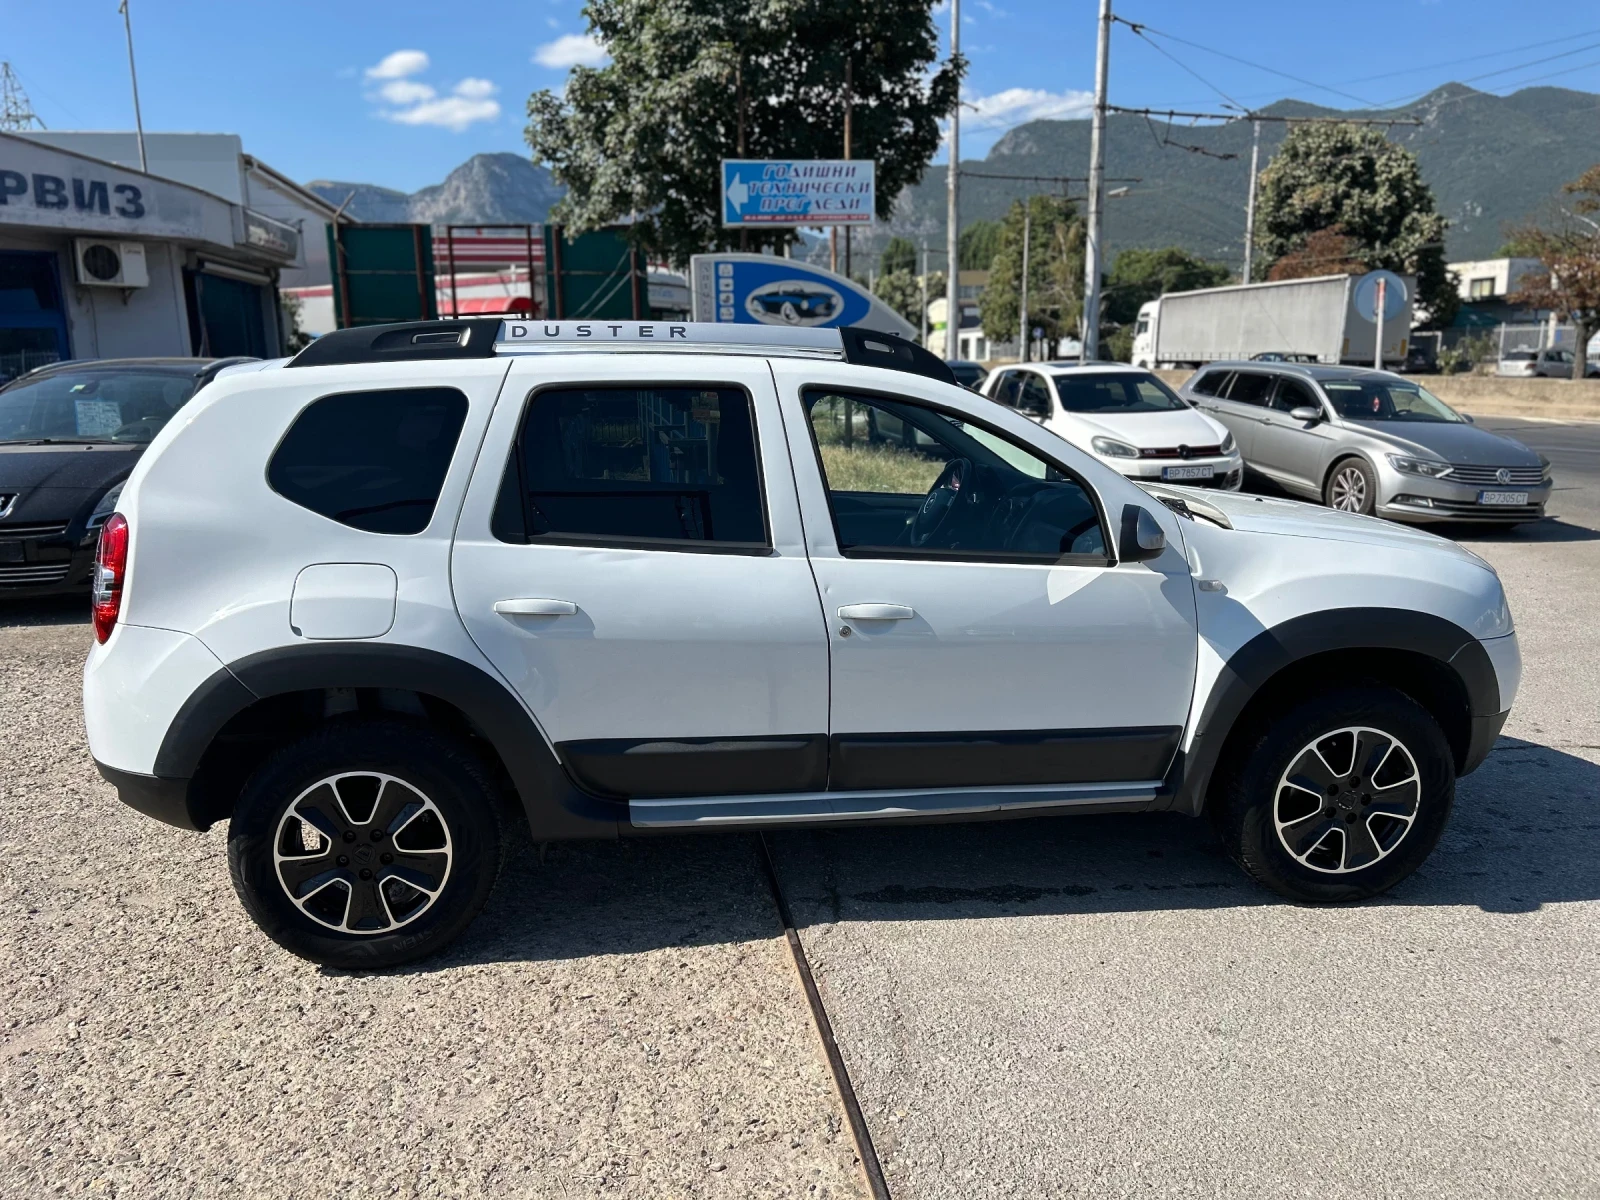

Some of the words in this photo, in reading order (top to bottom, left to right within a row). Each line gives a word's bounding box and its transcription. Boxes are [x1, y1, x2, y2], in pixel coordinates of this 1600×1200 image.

[763, 165, 857, 178] ГОДИШНИ
[0, 169, 146, 219] РВИЗ
[750, 181, 870, 194] ТЕХНИЧЕСКИ
[761, 198, 861, 210] ПРЕГЛЕДИ
[511, 325, 687, 338] DUSTER
